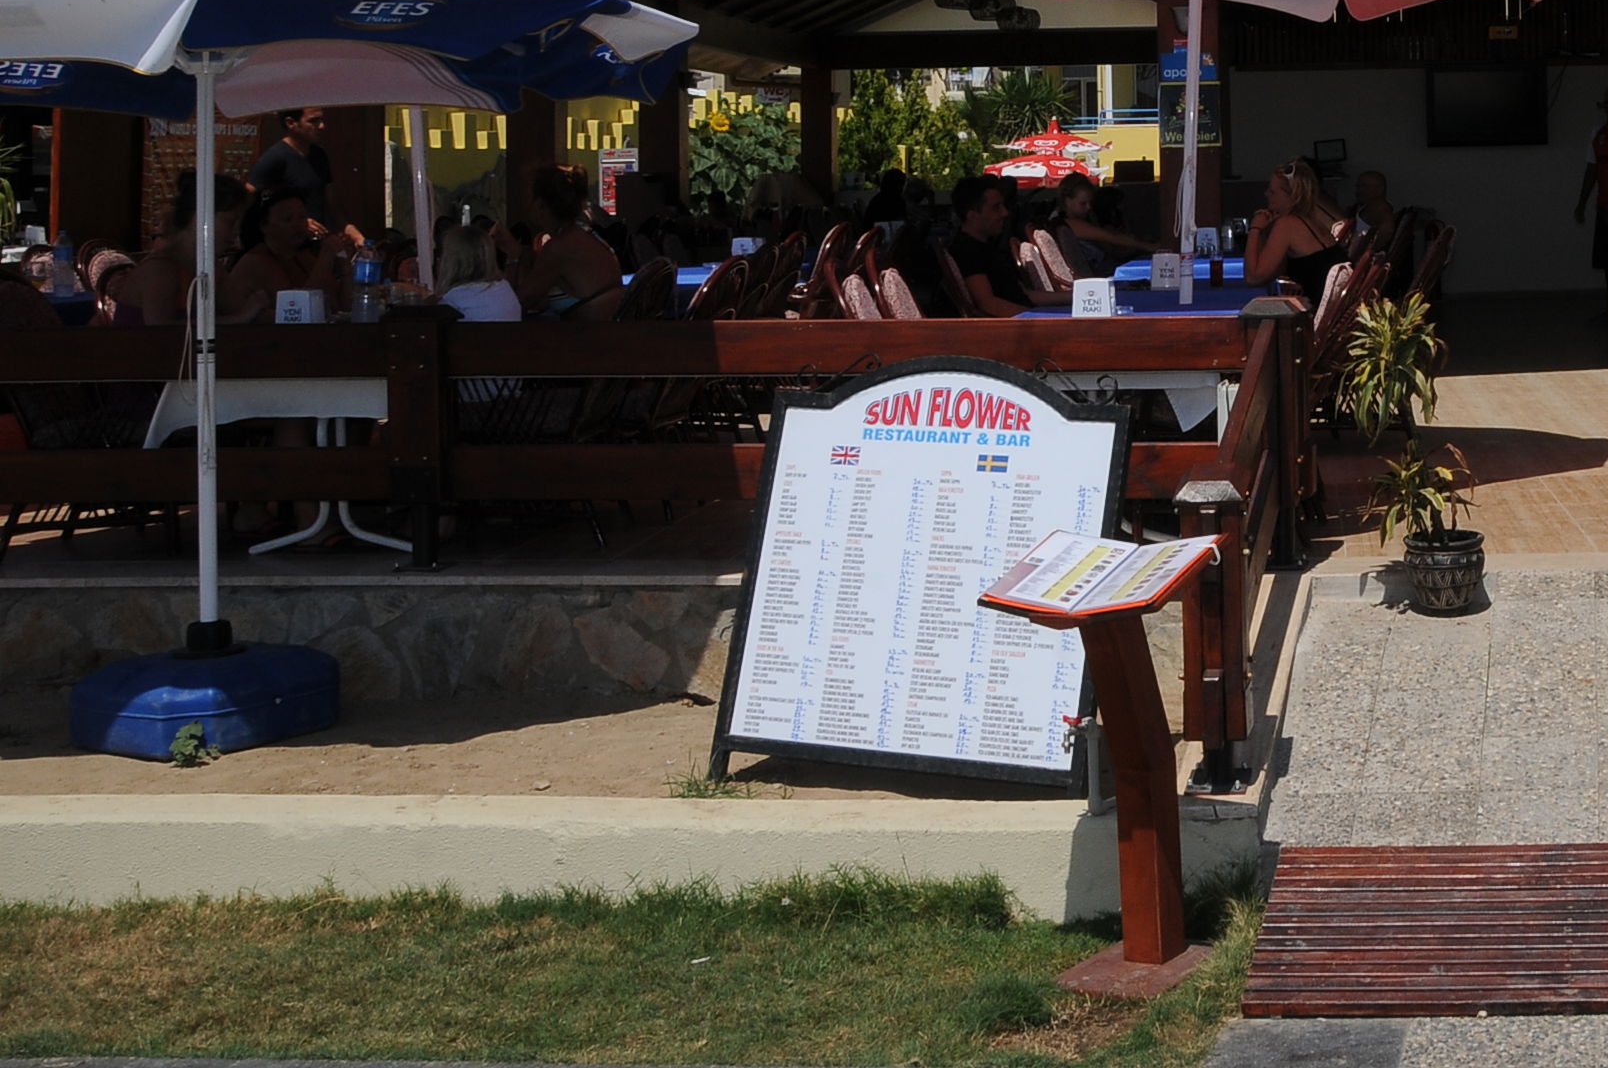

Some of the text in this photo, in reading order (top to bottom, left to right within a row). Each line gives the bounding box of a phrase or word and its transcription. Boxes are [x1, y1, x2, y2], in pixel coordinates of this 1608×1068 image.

[350, 1, 435, 16] EFES
[763, 86, 785, 96] WC
[863, 387, 1032, 431] SUN FLOWER
[862, 428, 1031, 447] RESTAURANT & BAR
